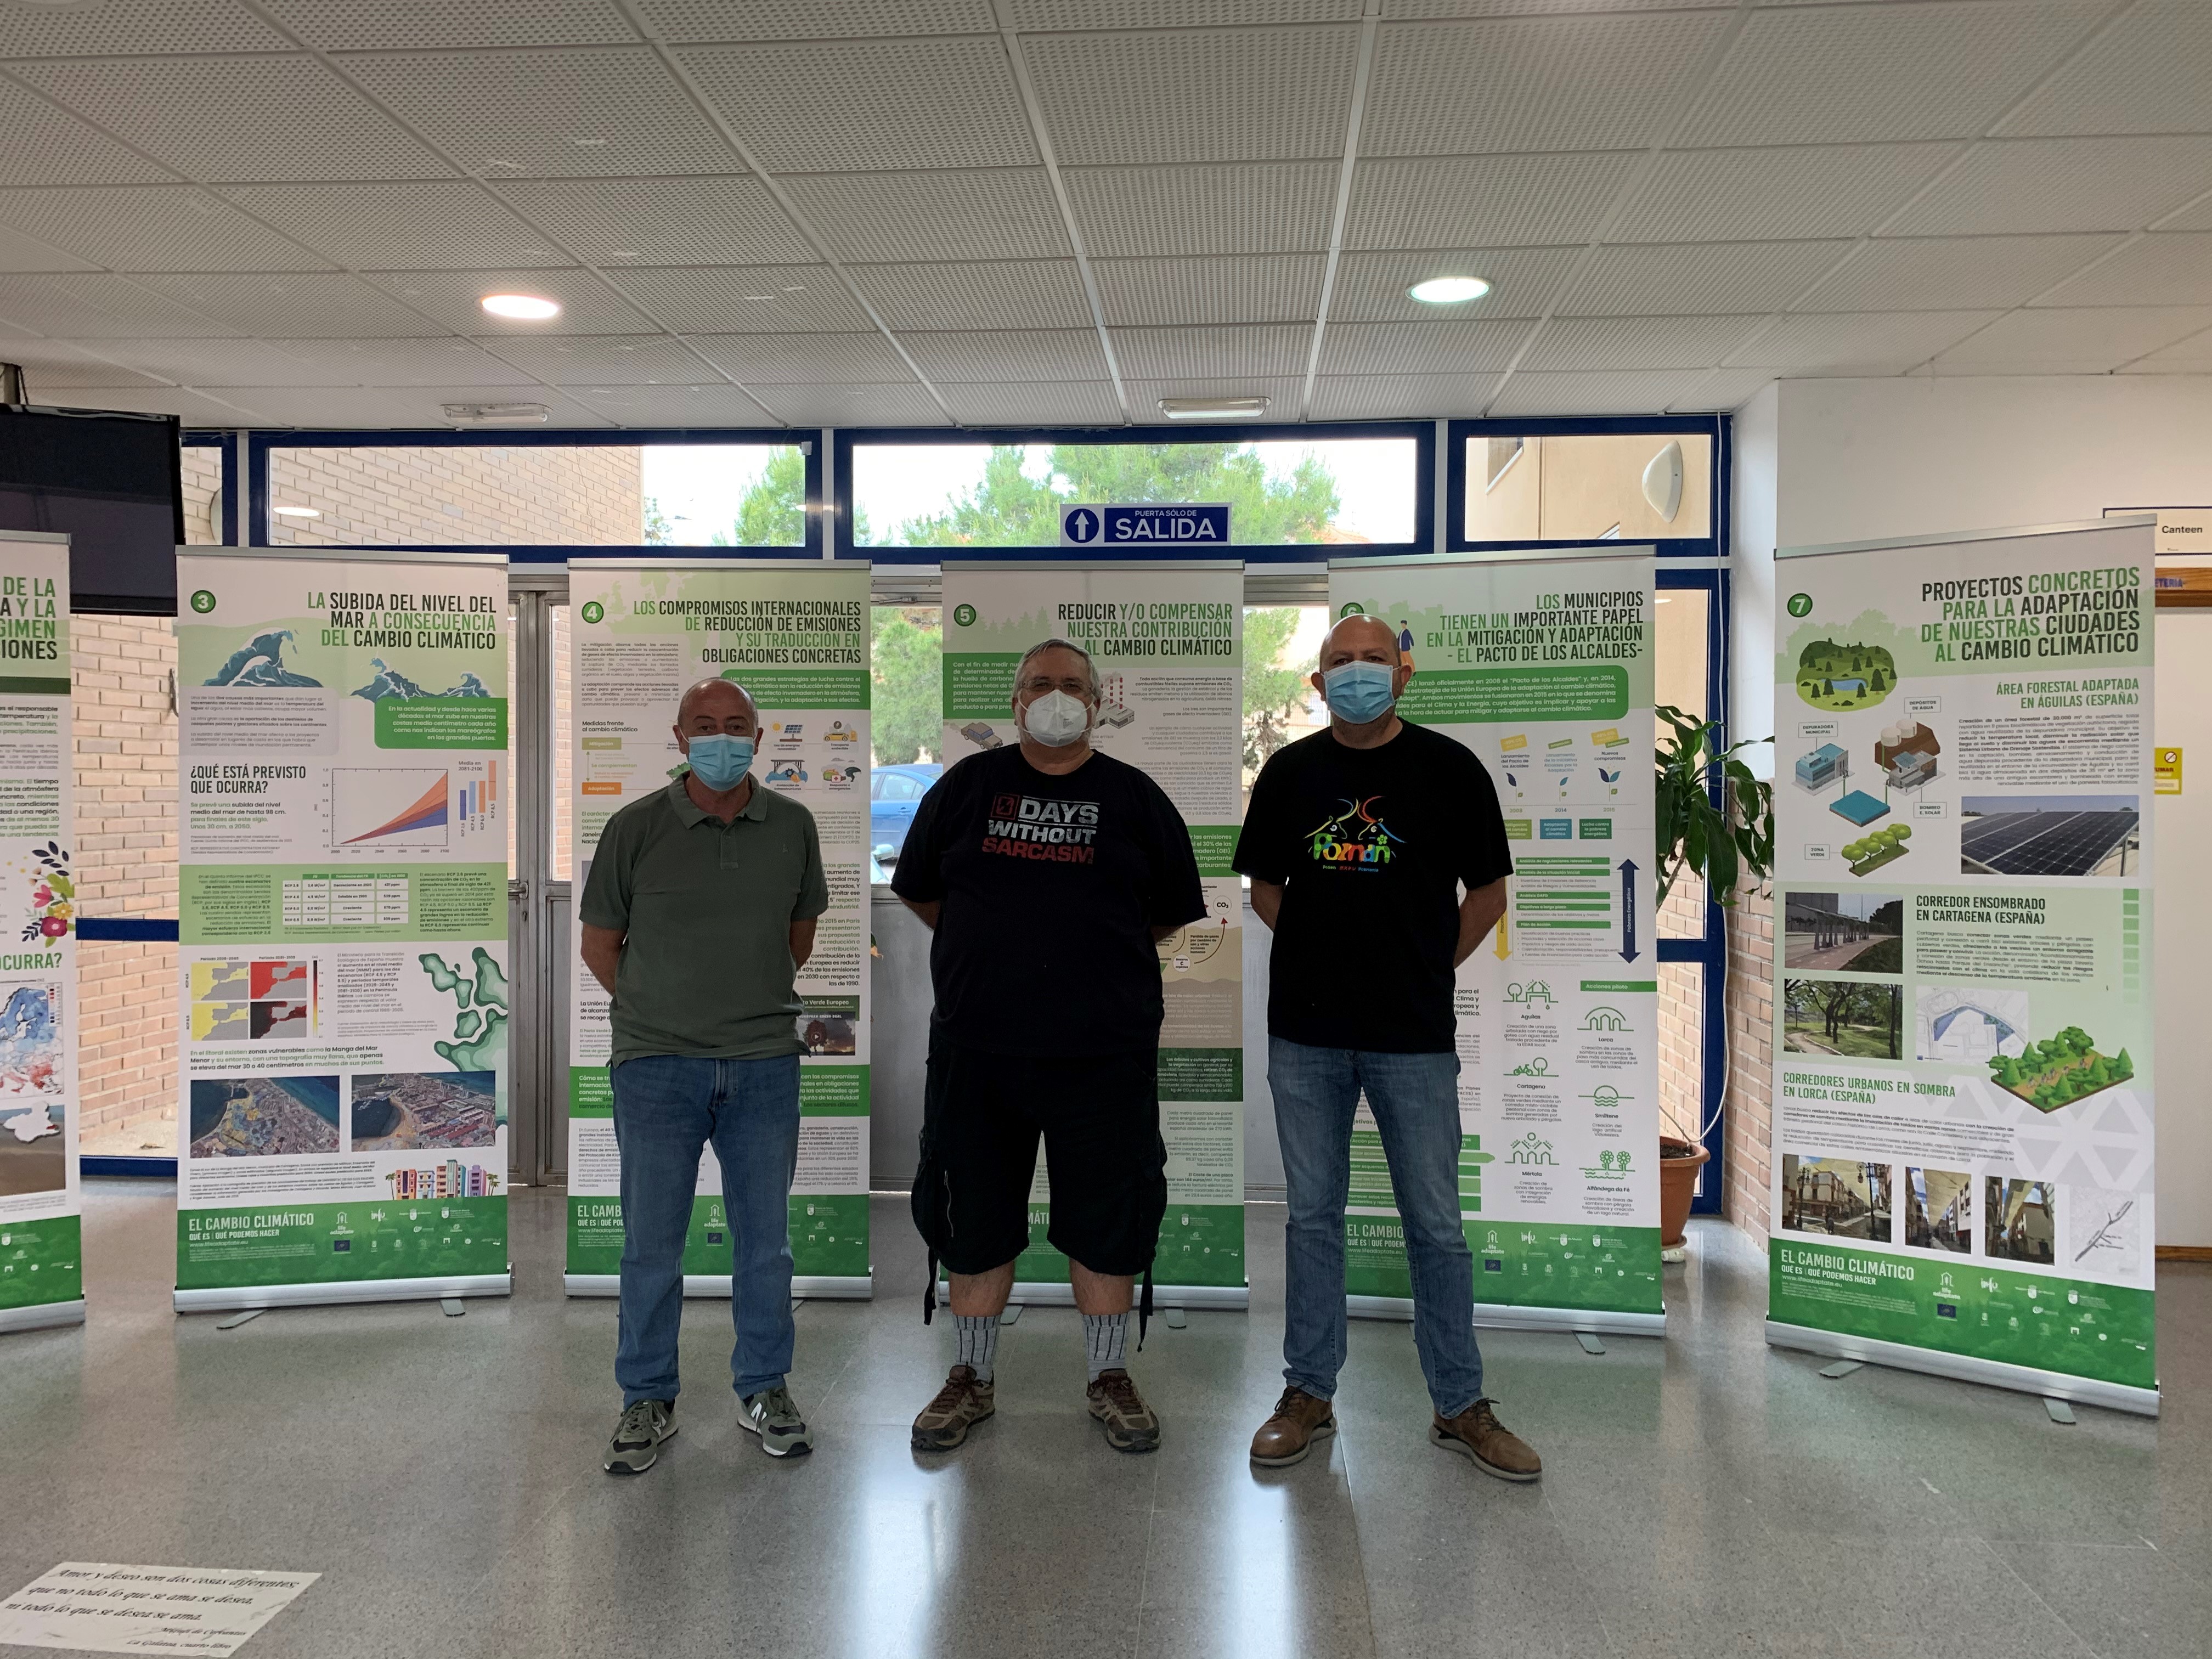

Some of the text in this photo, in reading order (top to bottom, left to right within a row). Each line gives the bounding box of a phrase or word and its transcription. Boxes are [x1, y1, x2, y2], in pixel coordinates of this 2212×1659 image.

[1115, 518, 1216, 539] SALIDA
[4, 576, 55, 597] DE LA
[1922, 567, 2140, 601] PROYECTOS CONCRETOS
[17, 598, 28, 616] Y
[35, 599, 55, 618] LA
[198, 594, 208, 608] 3
[308, 592, 496, 613] LA SUBIDA DEL NIVEL DEL
[634, 600, 861, 616] LOS COMPROMISOS INTERNACIONALES
[1537, 591, 1643, 609] LOS MUNICIPIOS
[1796, 598, 1807, 613] 7
[1943, 589, 2138, 620] PARA LA ADAPTACIÓN
[331, 611, 495, 630] MAR A CONSECUENCIA
[586, 606, 597, 620] 4
[961, 608, 969, 622] 5
[1059, 603, 1232, 620] REDUCIR Y/O COMPENSAR
[1440, 608, 1643, 629] TIENEN UN IMPORTANTE PAPEL
[686, 614, 861, 631] DE REDUCCIÓN DE EMISIONES
[1068, 618, 1231, 637] NUESTRA CONTRIBUCIÓN
[1922, 611, 2140, 642] DE NUESTRAS CIUDADES
[322, 629, 495, 649] DEL CAMBIO CLIMÁTICO
[737, 630, 860, 647] Y SU TRADUCCIÓN EN
[1427, 623, 1642, 647] EN LA MITIGACIÓN Y ADAPTACIÓN
[703, 648, 861, 663] OBLIGACIONES CONCRETAS
[1084, 637, 1231, 656] AL CAMBIO CLIMÁTICO
[1458, 648, 1472, 663] EL
[1477, 647, 1516, 662] PACTO
[1522, 646, 1538, 661] DE
[1543, 645, 1566, 660] LOS
[1936, 632, 2138, 662] AL CAMBIO CLIMÁTICO
[1996, 678, 2138, 695] ÁREA FORESTAL ADAPTADA
[2021, 693, 2138, 708] EN ÁGUILAS (ESPAÑA)
[191, 764, 306, 778] ¿QUÉ ESTÁ PREVISTO
[191, 780, 268, 794] QUE OCURRA?
[1018, 798, 1098, 824] DAYS
[988, 820, 1096, 844] WITHOUT
[982, 837, 1094, 864] SARCASM
[1917, 895, 2045, 909] CORREDOR ENSOMBRADO
[1917, 909, 2045, 924] EN CARTAGENA (ESPAÑA)
[0, 952, 62, 970] CURRA?
[1784, 1072, 1955, 1097] CORREDORES URBANOS EN SOMBRA
[1784, 1086, 1875, 1103] EN LORCA (ESPAÑA)
[189, 1212, 314, 1231] EL CAMBIO CLIMÁTICO
[1781, 1249, 1914, 1280] EL CAMBIO CLIMÁTICO
[104, 1571, 140, 1580] deseo
[108, 1589, 124, 1597] lo
[122, 1592, 150, 1600] que
[22, 1603, 55, 1612] todo
[54, 1604, 70, 1612] lo
[69, 1607, 97, 1616] que
